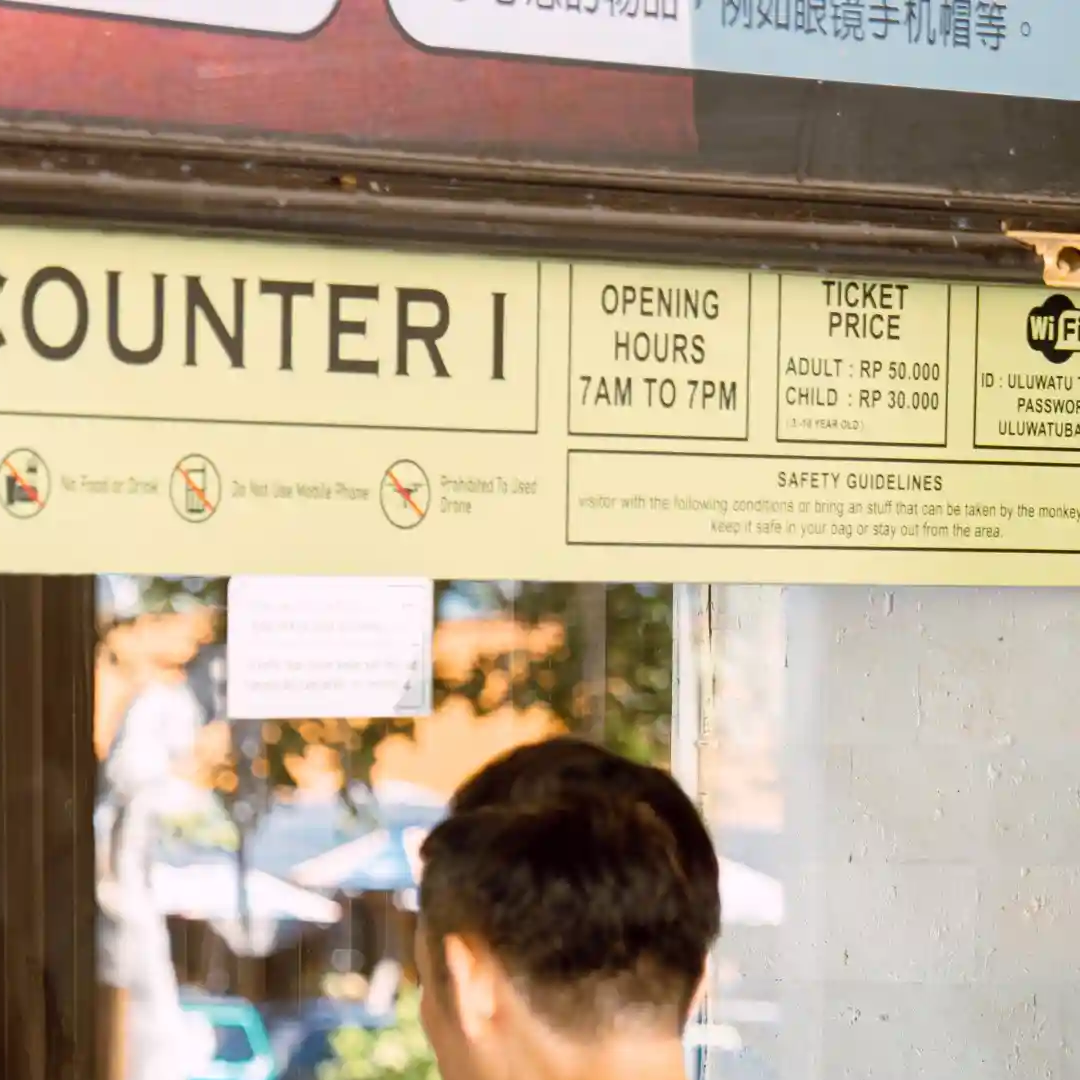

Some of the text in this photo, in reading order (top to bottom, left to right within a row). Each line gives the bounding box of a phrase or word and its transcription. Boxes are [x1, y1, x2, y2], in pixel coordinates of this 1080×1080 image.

[602, 285, 718, 320] OPENING
[821, 280, 909, 310] TICKET
[829, 312, 900, 340] PRICE
[615, 332, 705, 364] HOURS
[785, 356, 844, 378] ADULT
[860, 359, 883, 379] RP
[888, 361, 940, 382] 50.000
[981, 372, 995, 388] ID
[1007, 373, 1073, 392] ULUWATU
[580, 376, 736, 410] 7AM TO 7PM
[785, 385, 838, 407] CHILD
[859, 389, 882, 408] RP
[887, 390, 940, 411] 30.000
[814, 418, 838, 429] YEAR
[777, 470, 943, 492] SAFETY GUIDELINES
[620, 494, 646, 509] with
[648, 495, 671, 511] the
[814, 499, 845, 519] bring
[895, 502, 919, 516] that
[921, 504, 943, 516] can
[964, 503, 997, 517] taken
[999, 503, 1014, 521] by
[1017, 503, 1035, 518] the
[710, 520, 742, 536] keep
[755, 518, 783, 535] safe
[800, 522, 828, 539] your
[872, 523, 896, 540] stay
[900, 523, 920, 537] out
[922, 521, 949, 537] from
[952, 523, 971, 538] the
